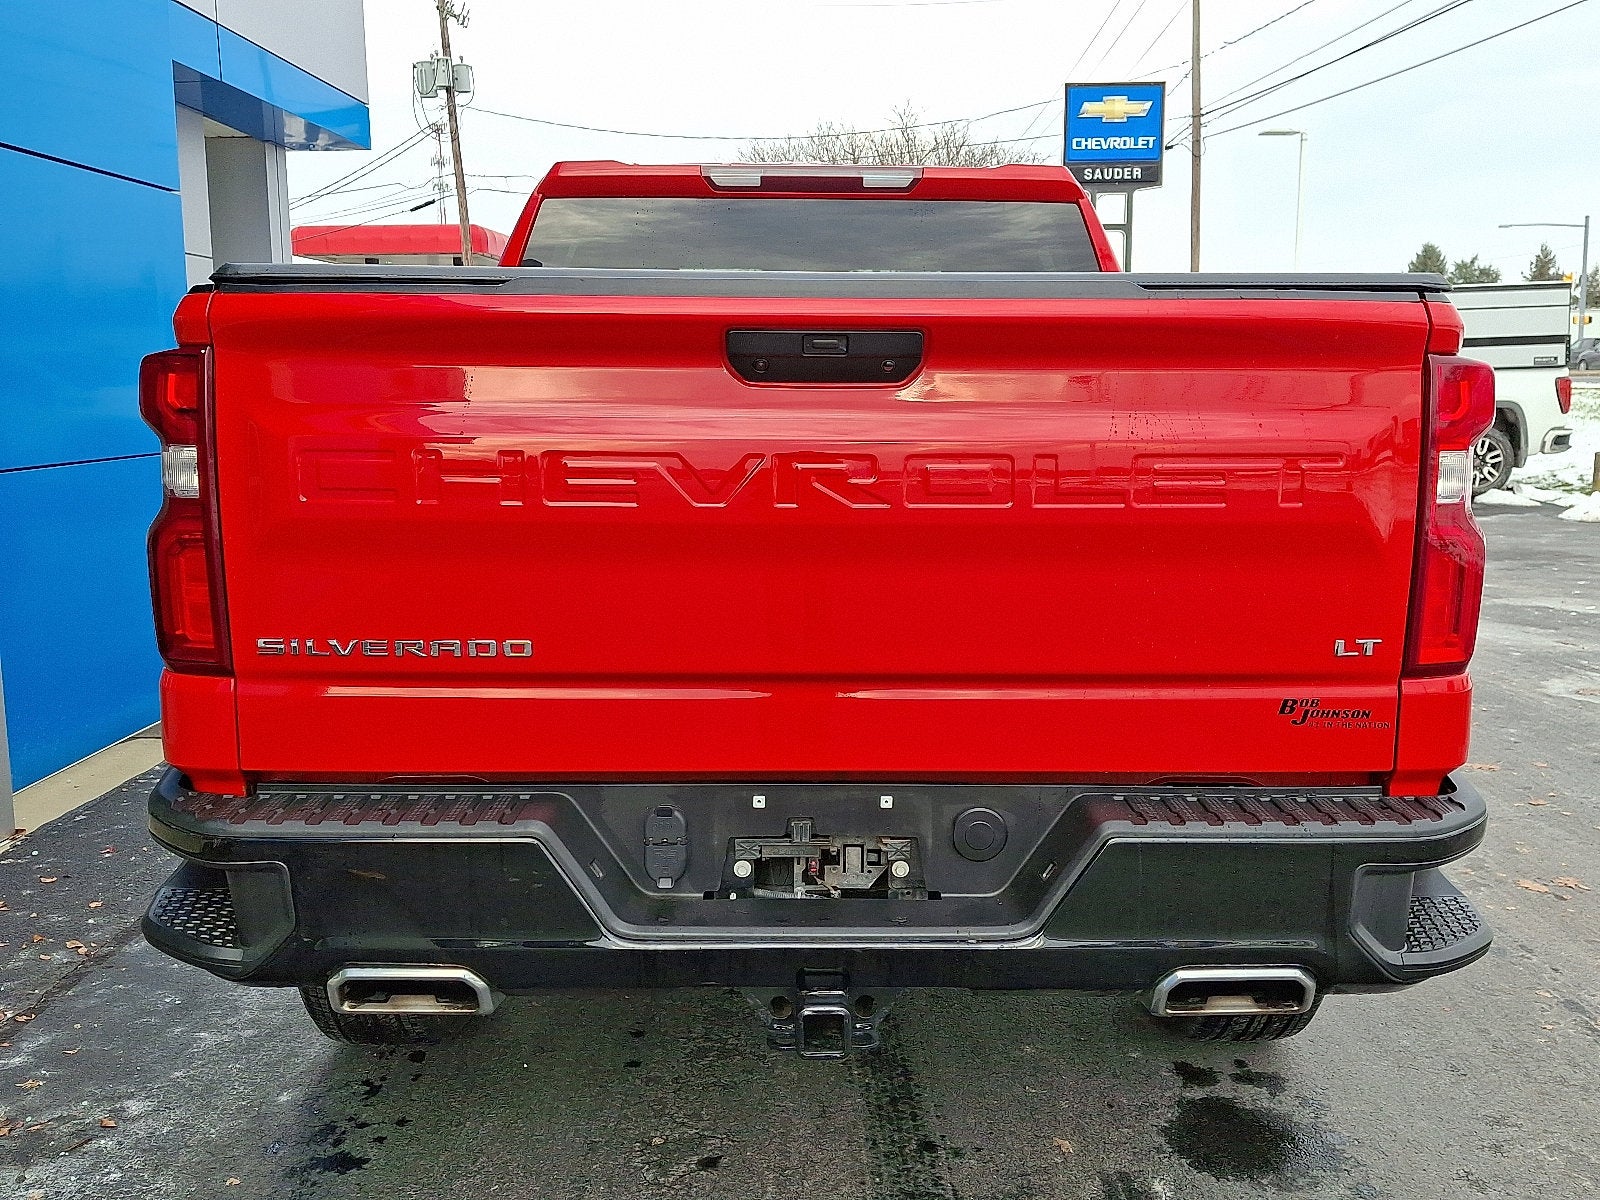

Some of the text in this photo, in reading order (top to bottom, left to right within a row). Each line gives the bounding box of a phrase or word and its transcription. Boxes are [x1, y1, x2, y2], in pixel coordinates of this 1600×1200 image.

[1072, 137, 1156, 150] CHEVROLET
[1083, 167, 1142, 180] SAUDER
[295, 450, 1347, 509] CHEVROLET
[256, 638, 533, 657] SILVERADO
[1335, 639, 1383, 656] LT
[1279, 699, 1319, 715] BOB
[1291, 709, 1371, 725] JOHNSON
[1355, 721, 1390, 729] NATION
